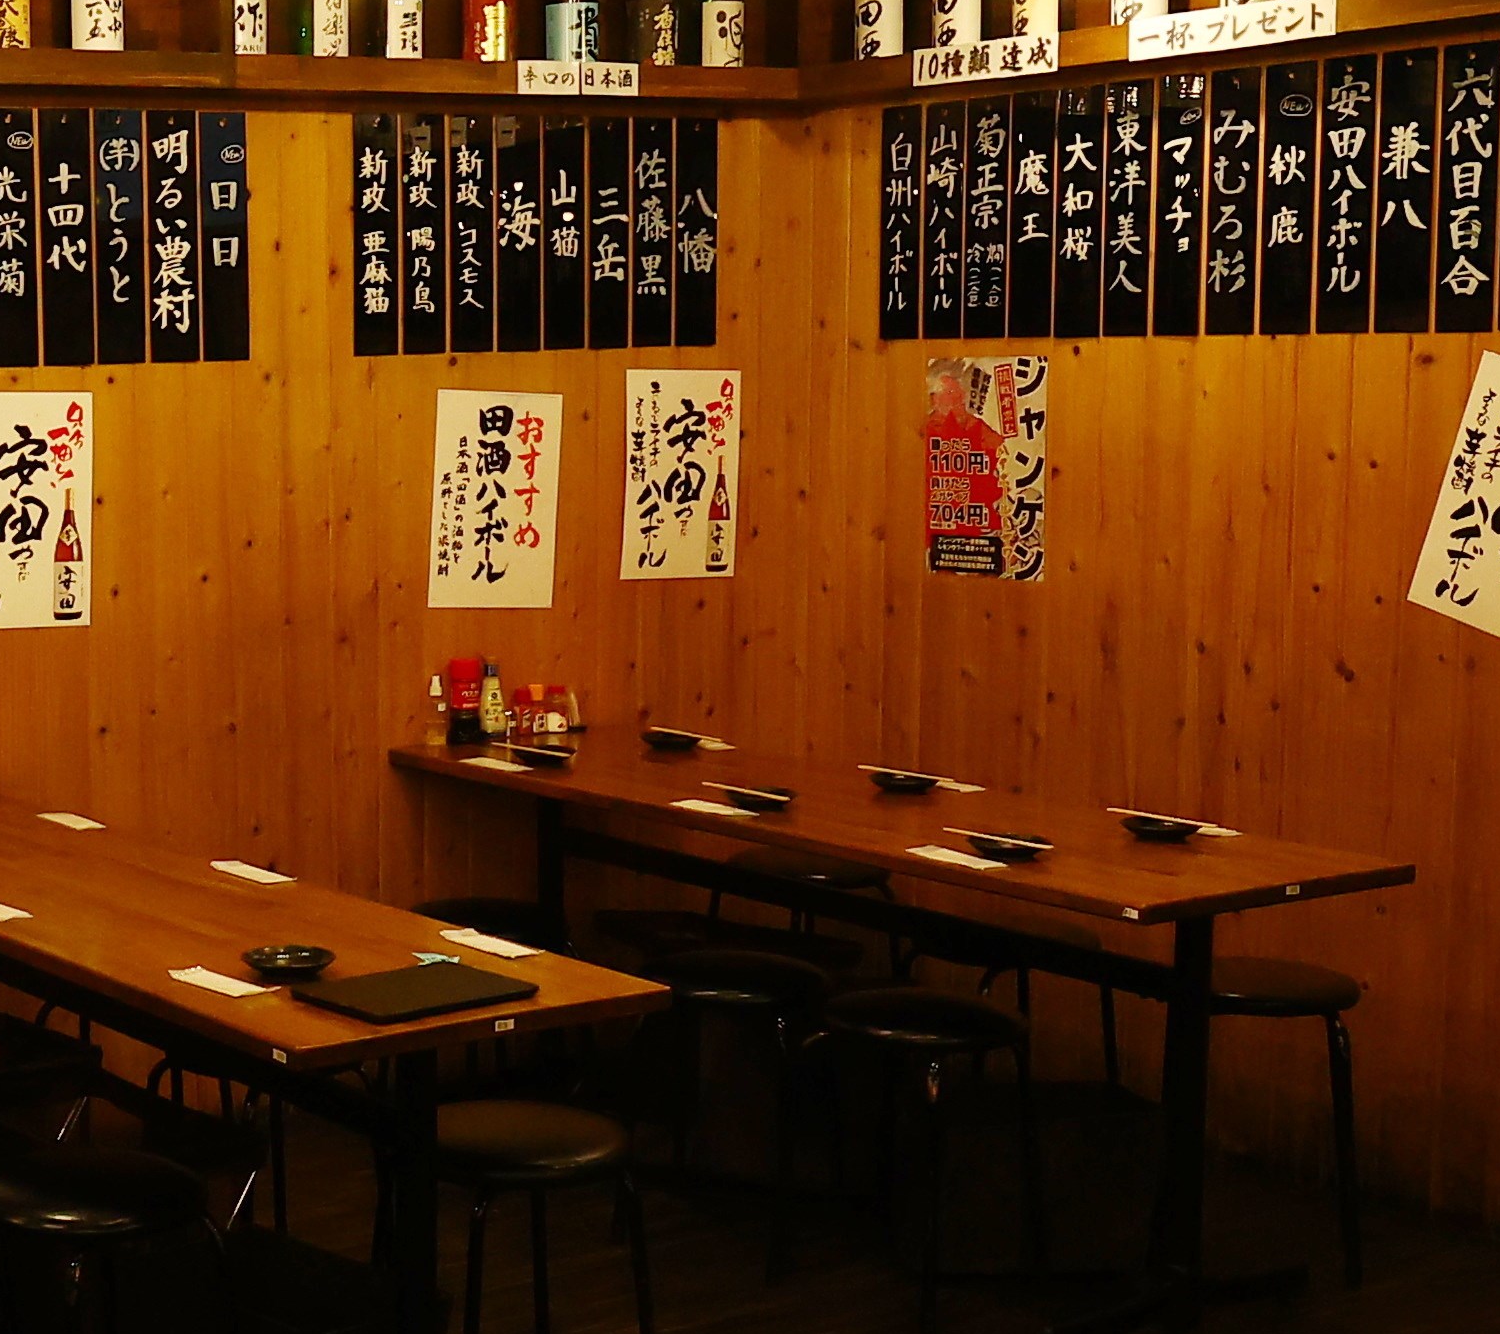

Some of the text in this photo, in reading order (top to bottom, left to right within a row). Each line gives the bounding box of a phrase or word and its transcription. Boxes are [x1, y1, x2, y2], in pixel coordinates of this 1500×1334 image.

[522, 66, 633, 90] 辛口の日本酒
[48, 163, 87, 272] 十四代
[209, 181, 240, 268] 日日
[409, 145, 437, 209] 新政
[455, 145, 485, 309] 新政 コスモス
[499, 195, 541, 251] 海
[550, 169, 579, 259] 山猫
[634, 148, 672, 296] 佐藤黒
[886, 132, 914, 312] 白州ハイボール
[926, 124, 959, 312] 山崎ハイボール
[971, 114, 1006, 230] 菊正宗
[1014, 150, 1050, 244] 魔王
[1060, 133, 1098, 262] 大和桜
[1109, 114, 1147, 294] 東洋美人
[1164, 136, 1193, 254] マッチョ
[1208, 109, 1256, 294] みむろ杉
[1268, 144, 1306, 248] 秋鹿
[1326, 75, 1372, 294] 安田ハイボール
[1381, 121, 1431, 230] 兼八
[1441, 68, 1496, 296] 六代目百合
[151, 130, 195, 334] 明るい農村
[359, 147, 392, 314] 新政 亜麻猫
[592, 187, 629, 282] 三岳
[678, 187, 718, 274] 八幡
[471, 405, 515, 584] 田酒ハイボール
[513, 410, 545, 548] おすすめ
[663, 398, 707, 505] 安田
[930, 451, 985, 474] 110円
[1013, 355, 1048, 581] ジャンケン
[1451, 388, 1498, 495] ような芋焼酎
[930, 503, 985, 526] 704円
[57, 565, 77, 610] 安田
